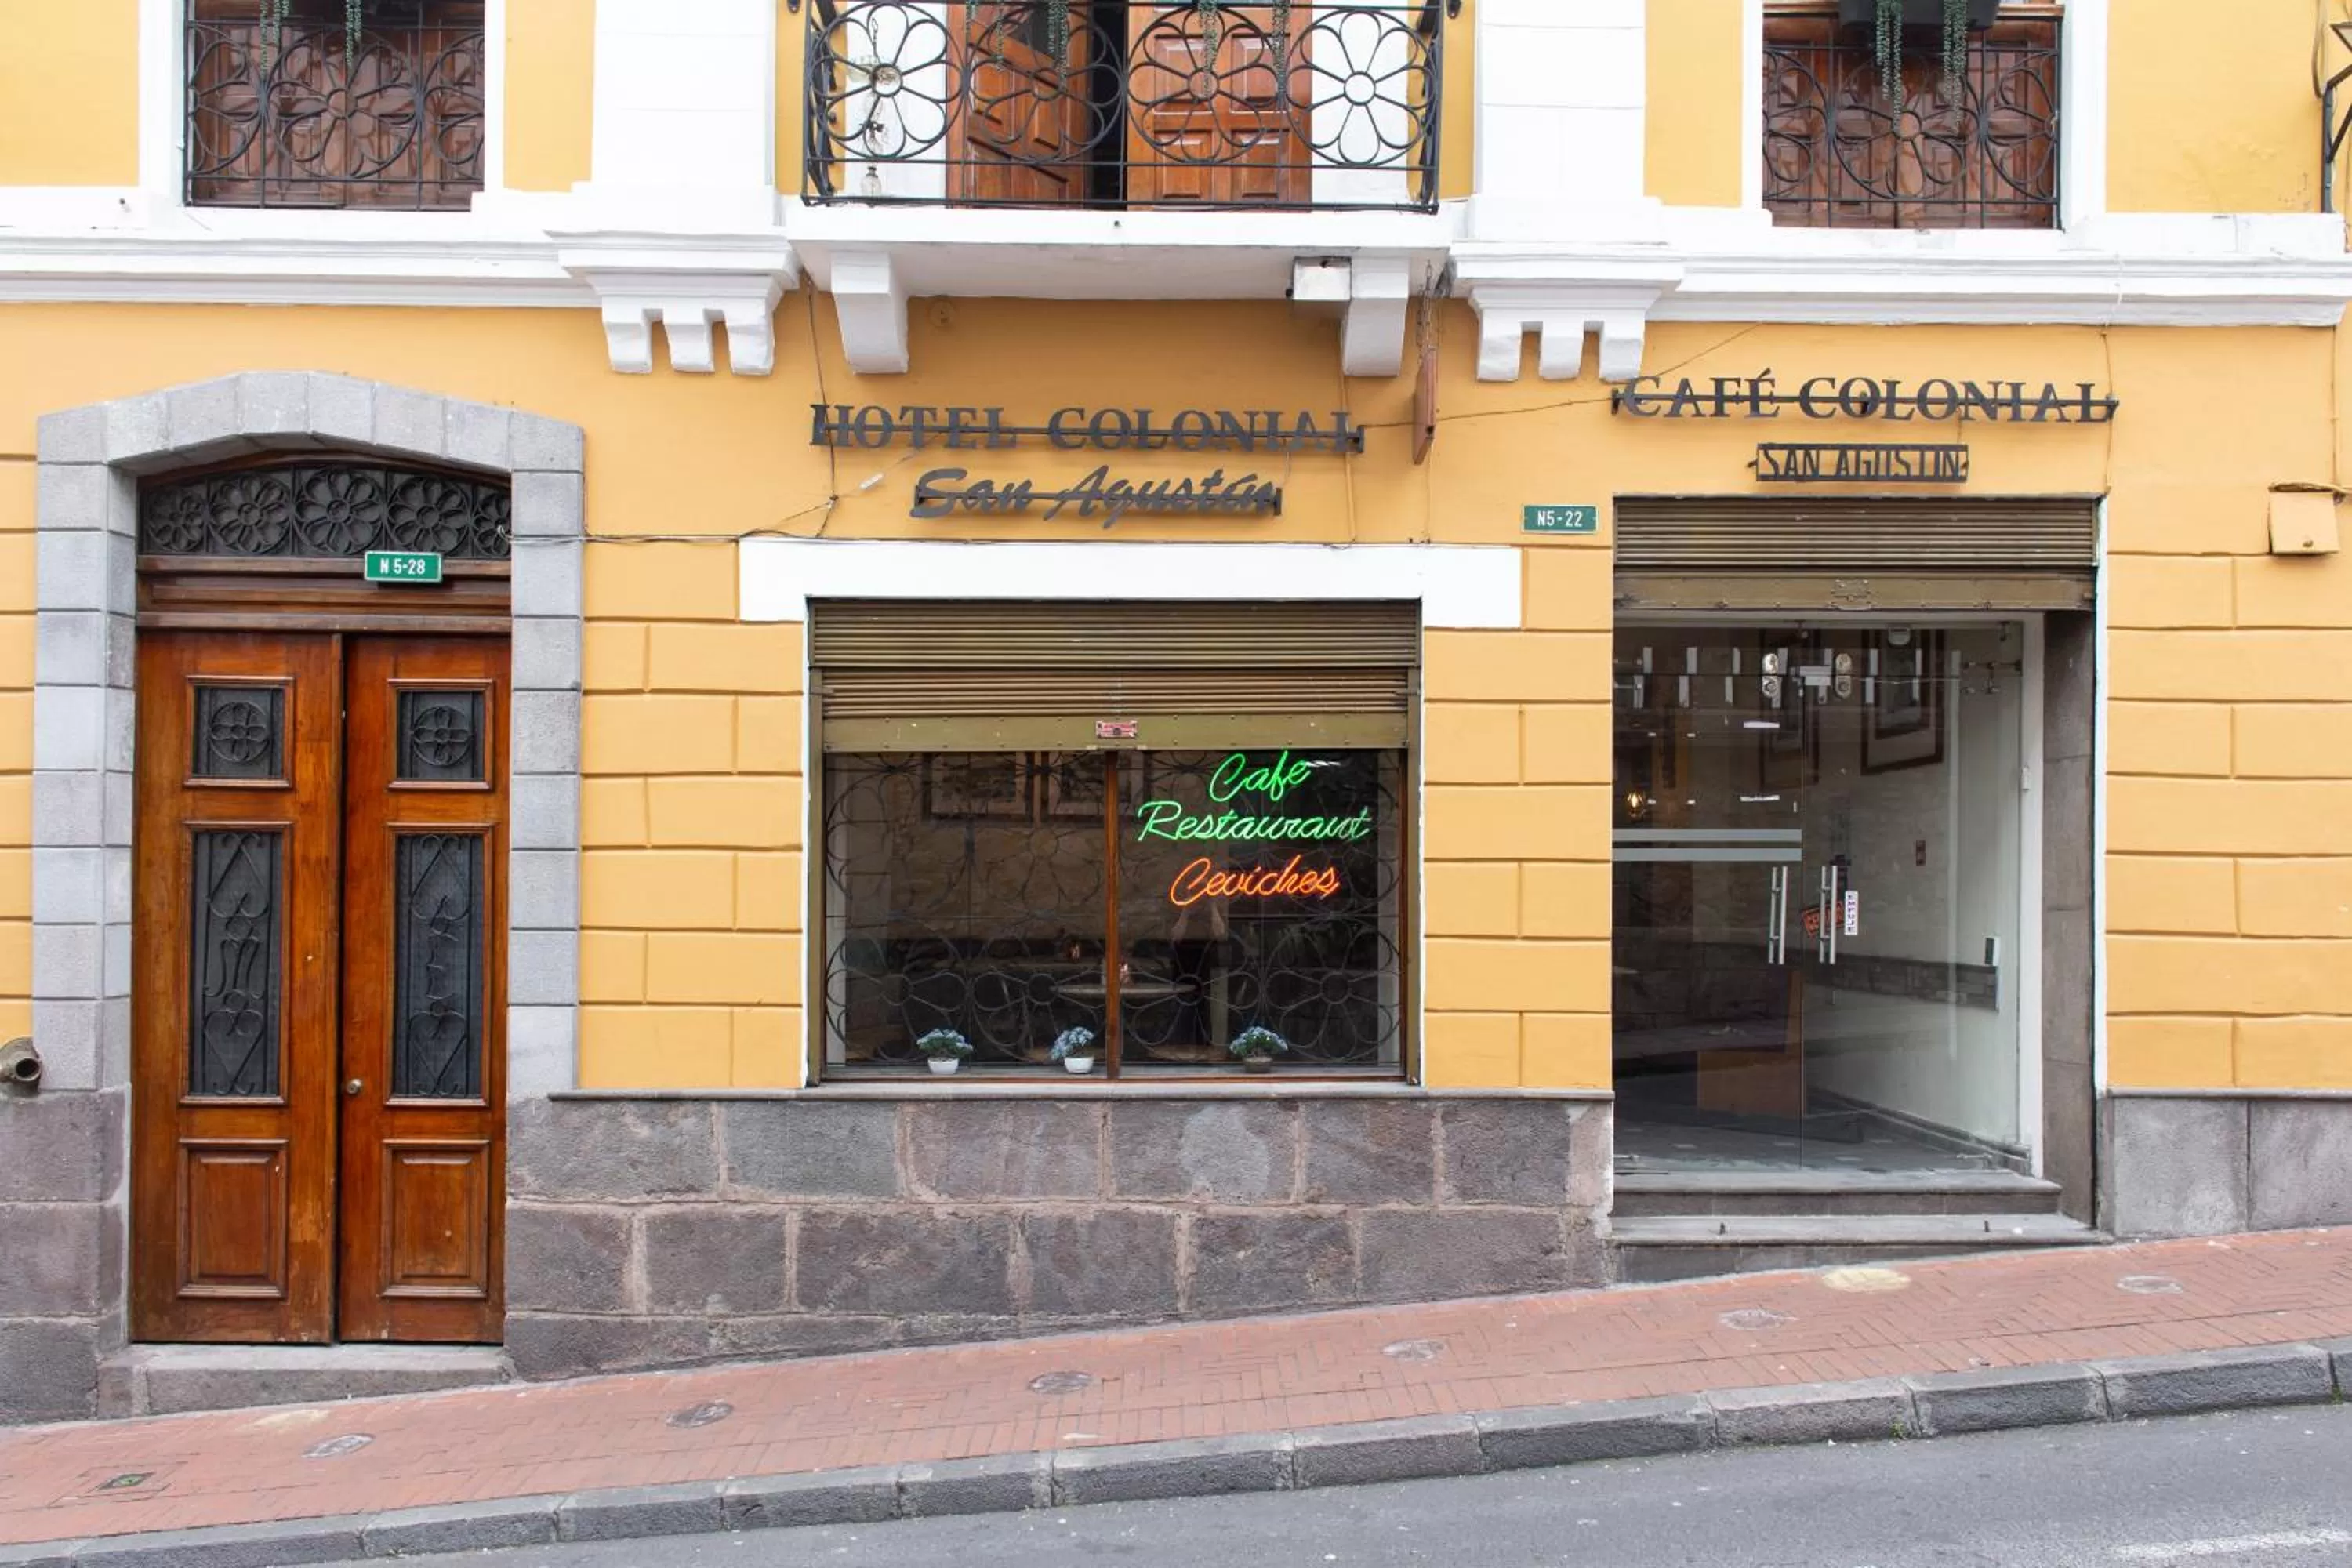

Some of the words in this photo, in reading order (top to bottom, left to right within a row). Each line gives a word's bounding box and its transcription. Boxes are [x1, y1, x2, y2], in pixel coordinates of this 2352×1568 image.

[1623, 368, 1780, 418] CAFÉ
[1799, 376, 2113, 423] COLONIAL
[811, 404, 1017, 449] HOTEL
[1048, 408, 1362, 452] COLONIAL
[1762, 446, 1820, 481] SAN
[1835, 446, 1962, 481] AGUSTIN
[909, 468, 1033, 518] San
[394, 557, 426, 575] 5-28
[1210, 750, 1311, 802] Cafe
[1138, 801, 1372, 842] Restaurant
[1170, 855, 1341, 906] Ceviches
